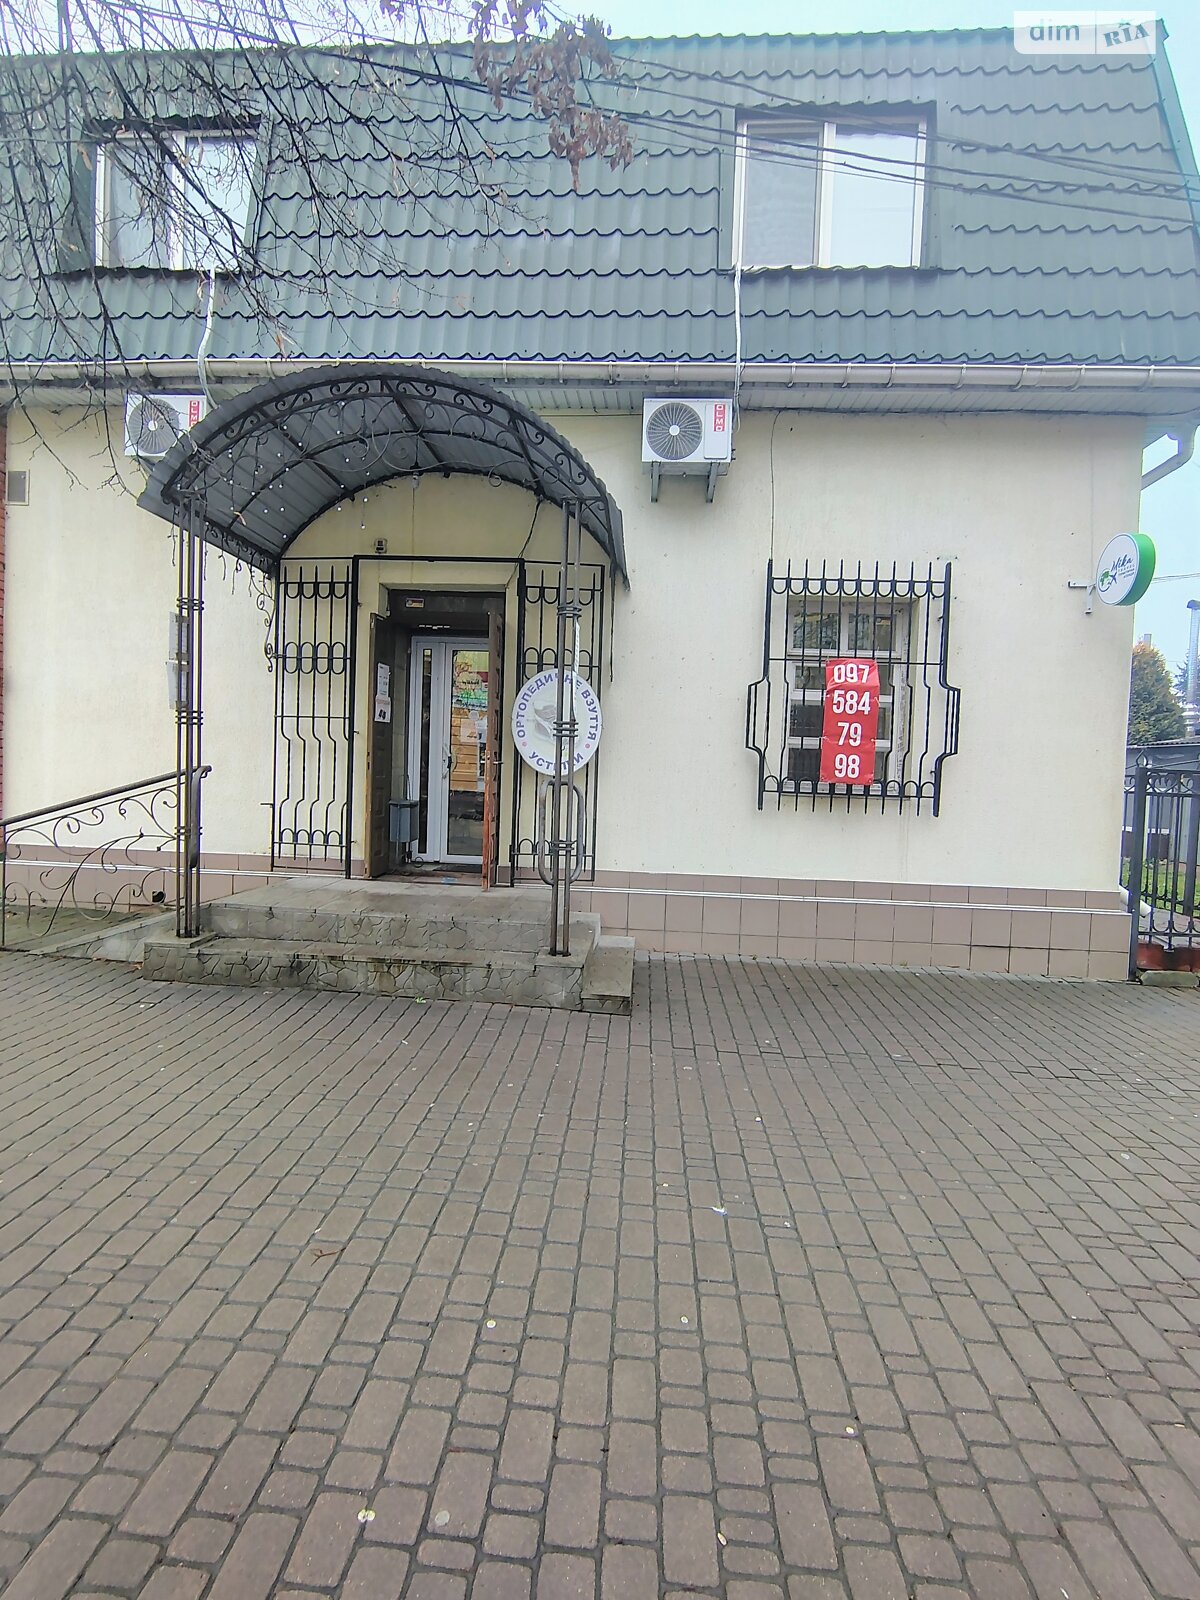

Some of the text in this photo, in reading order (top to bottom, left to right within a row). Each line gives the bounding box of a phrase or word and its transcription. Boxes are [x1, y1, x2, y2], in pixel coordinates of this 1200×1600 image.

[715, 404, 724, 432] OLMO
[832, 663, 870, 684] 097
[581, 689, 599, 741] ВЗУТТЯ
[832, 690, 871, 715] 584
[837, 722, 862, 747] 79
[528, 751, 584, 770] УСТЛИ
[834, 753, 860, 779] 98
